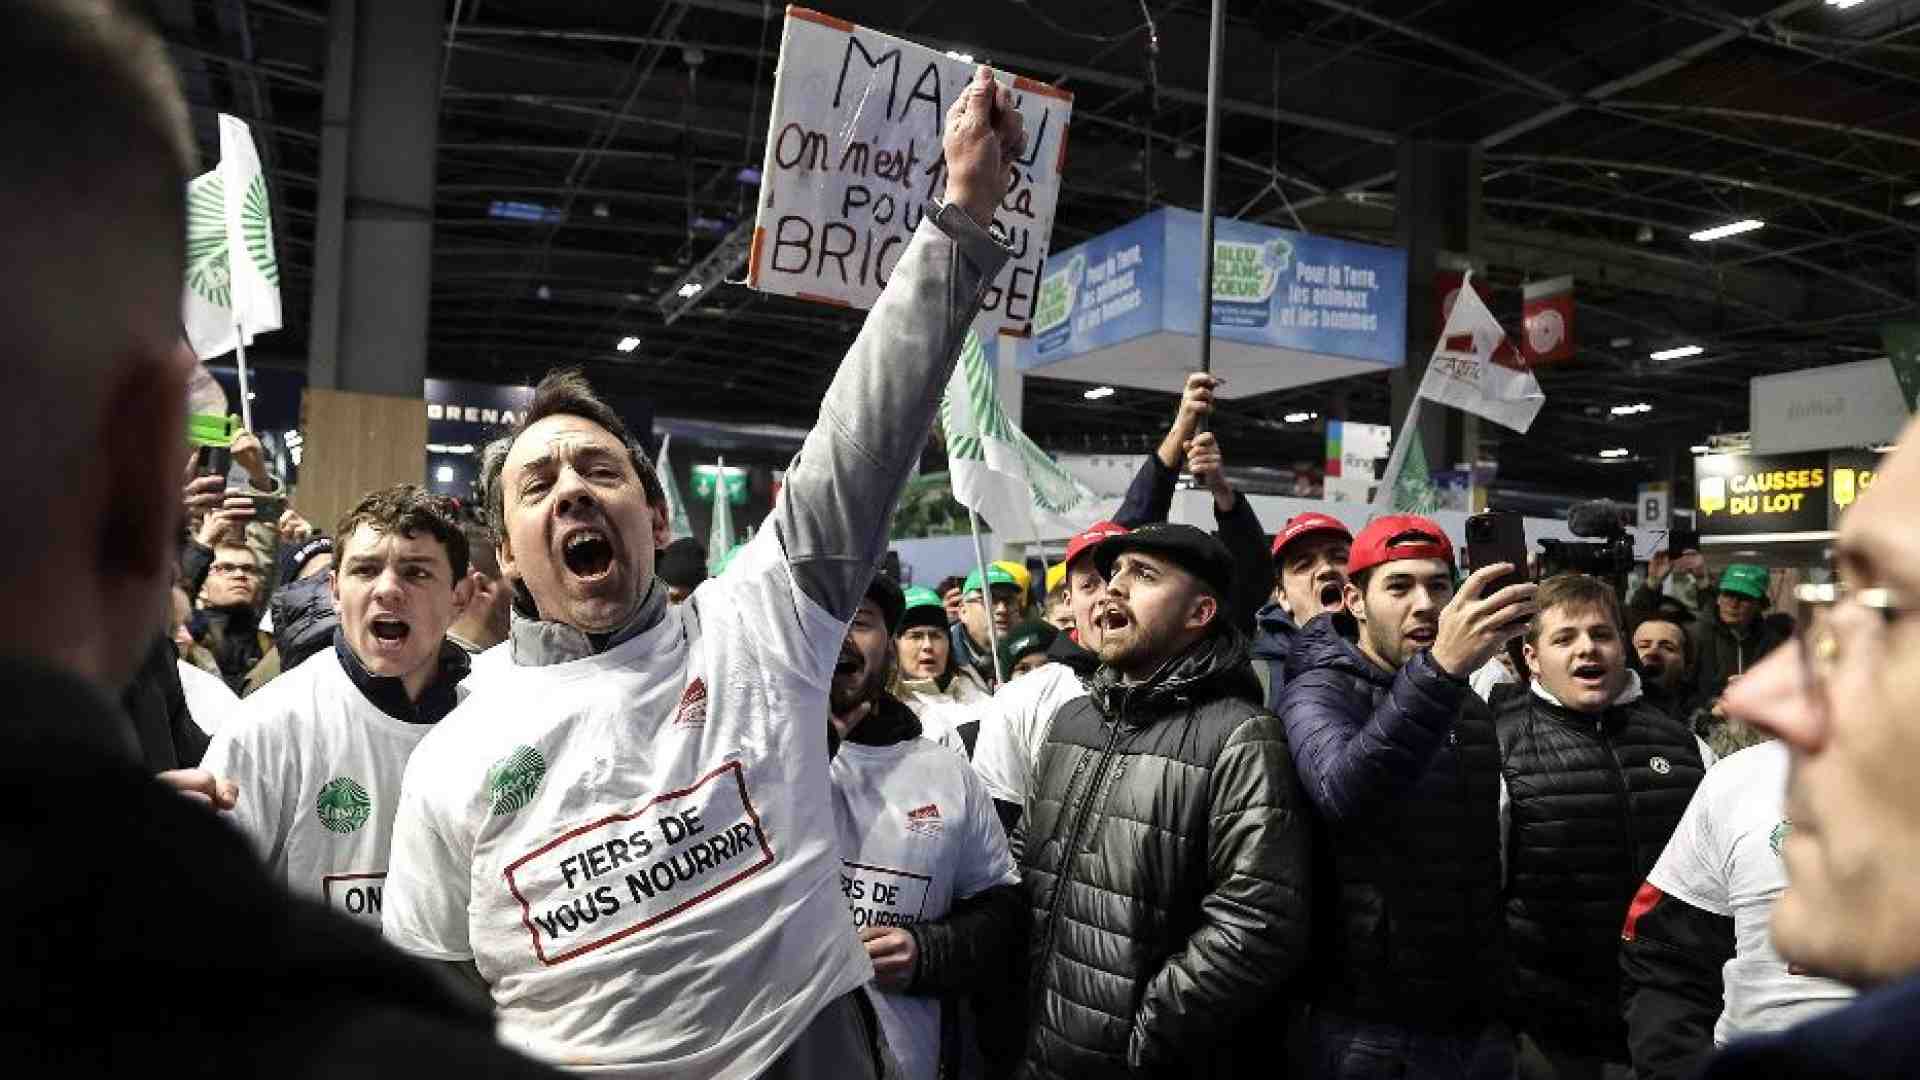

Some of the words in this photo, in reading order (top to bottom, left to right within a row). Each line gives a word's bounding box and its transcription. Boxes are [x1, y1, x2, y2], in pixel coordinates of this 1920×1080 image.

[833, 36, 1048, 167] MAU
[776, 122, 828, 171] On
[841, 184, 923, 234] POU
[1296, 262, 1326, 284] Pour
[1288, 283, 1310, 305] les
[1312, 285, 1369, 309] animaux
[1321, 309, 1378, 332] hommes
[1728, 468, 1825, 494] CAUSSES
[1646, 498, 1660, 521] B
[1728, 496, 1759, 516] DU
[1763, 493, 1804, 514] LOT
[559, 830, 653, 889] FIERS
[658, 806, 704, 846] DE
[534, 886, 620, 939] VOUS
[625, 821, 755, 904] NOURRIR
[345, 885, 382, 914] ON
[872, 881, 899, 906] DE
